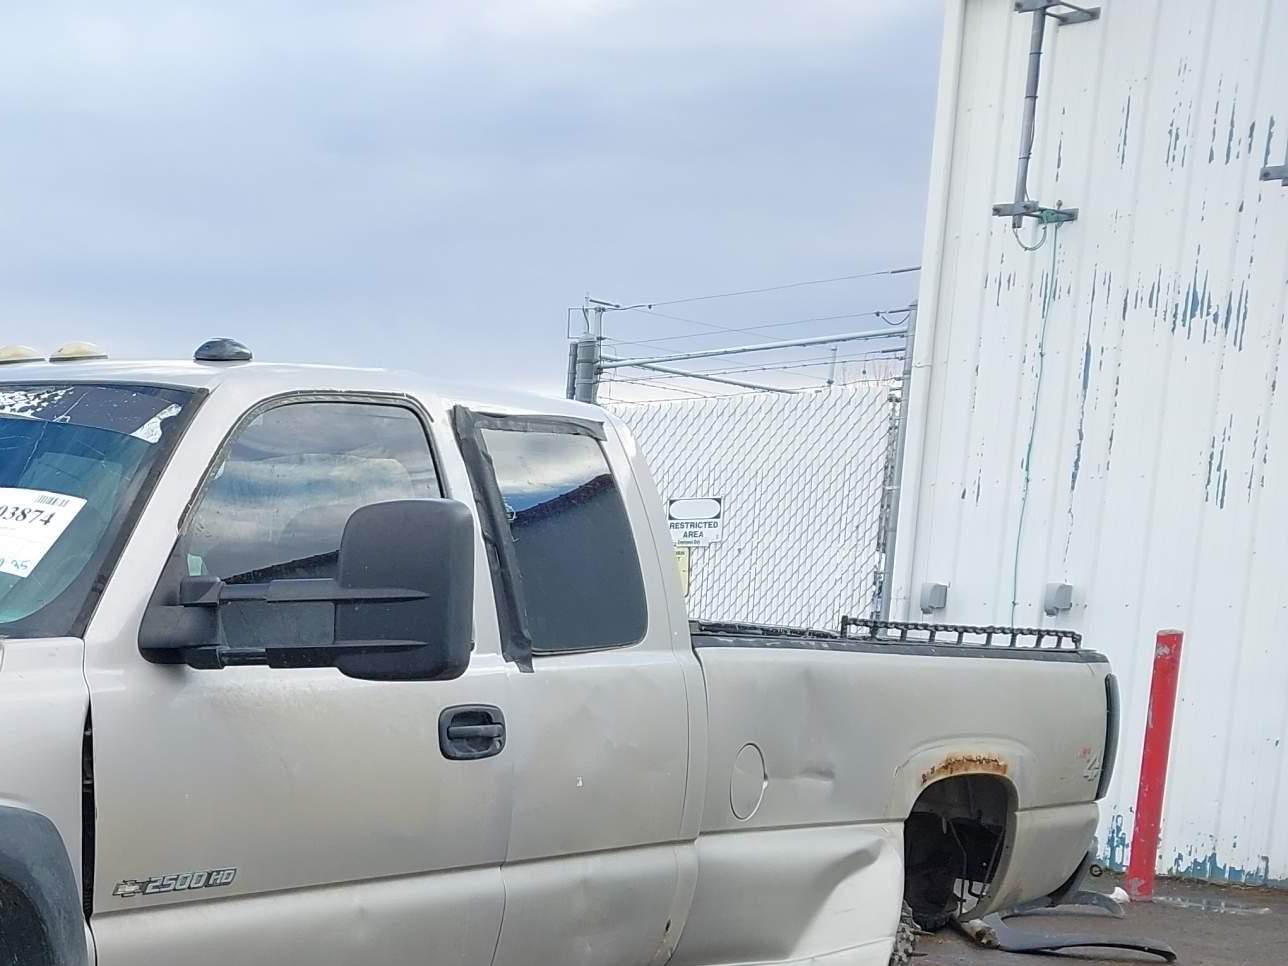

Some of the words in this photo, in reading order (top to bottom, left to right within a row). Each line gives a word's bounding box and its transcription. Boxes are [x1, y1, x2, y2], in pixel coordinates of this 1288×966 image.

[669, 522, 718, 530] RESTRICTED
[682, 530, 704, 538] AREA
[145, 870, 208, 895] 2500
[209, 869, 236, 885] HD
